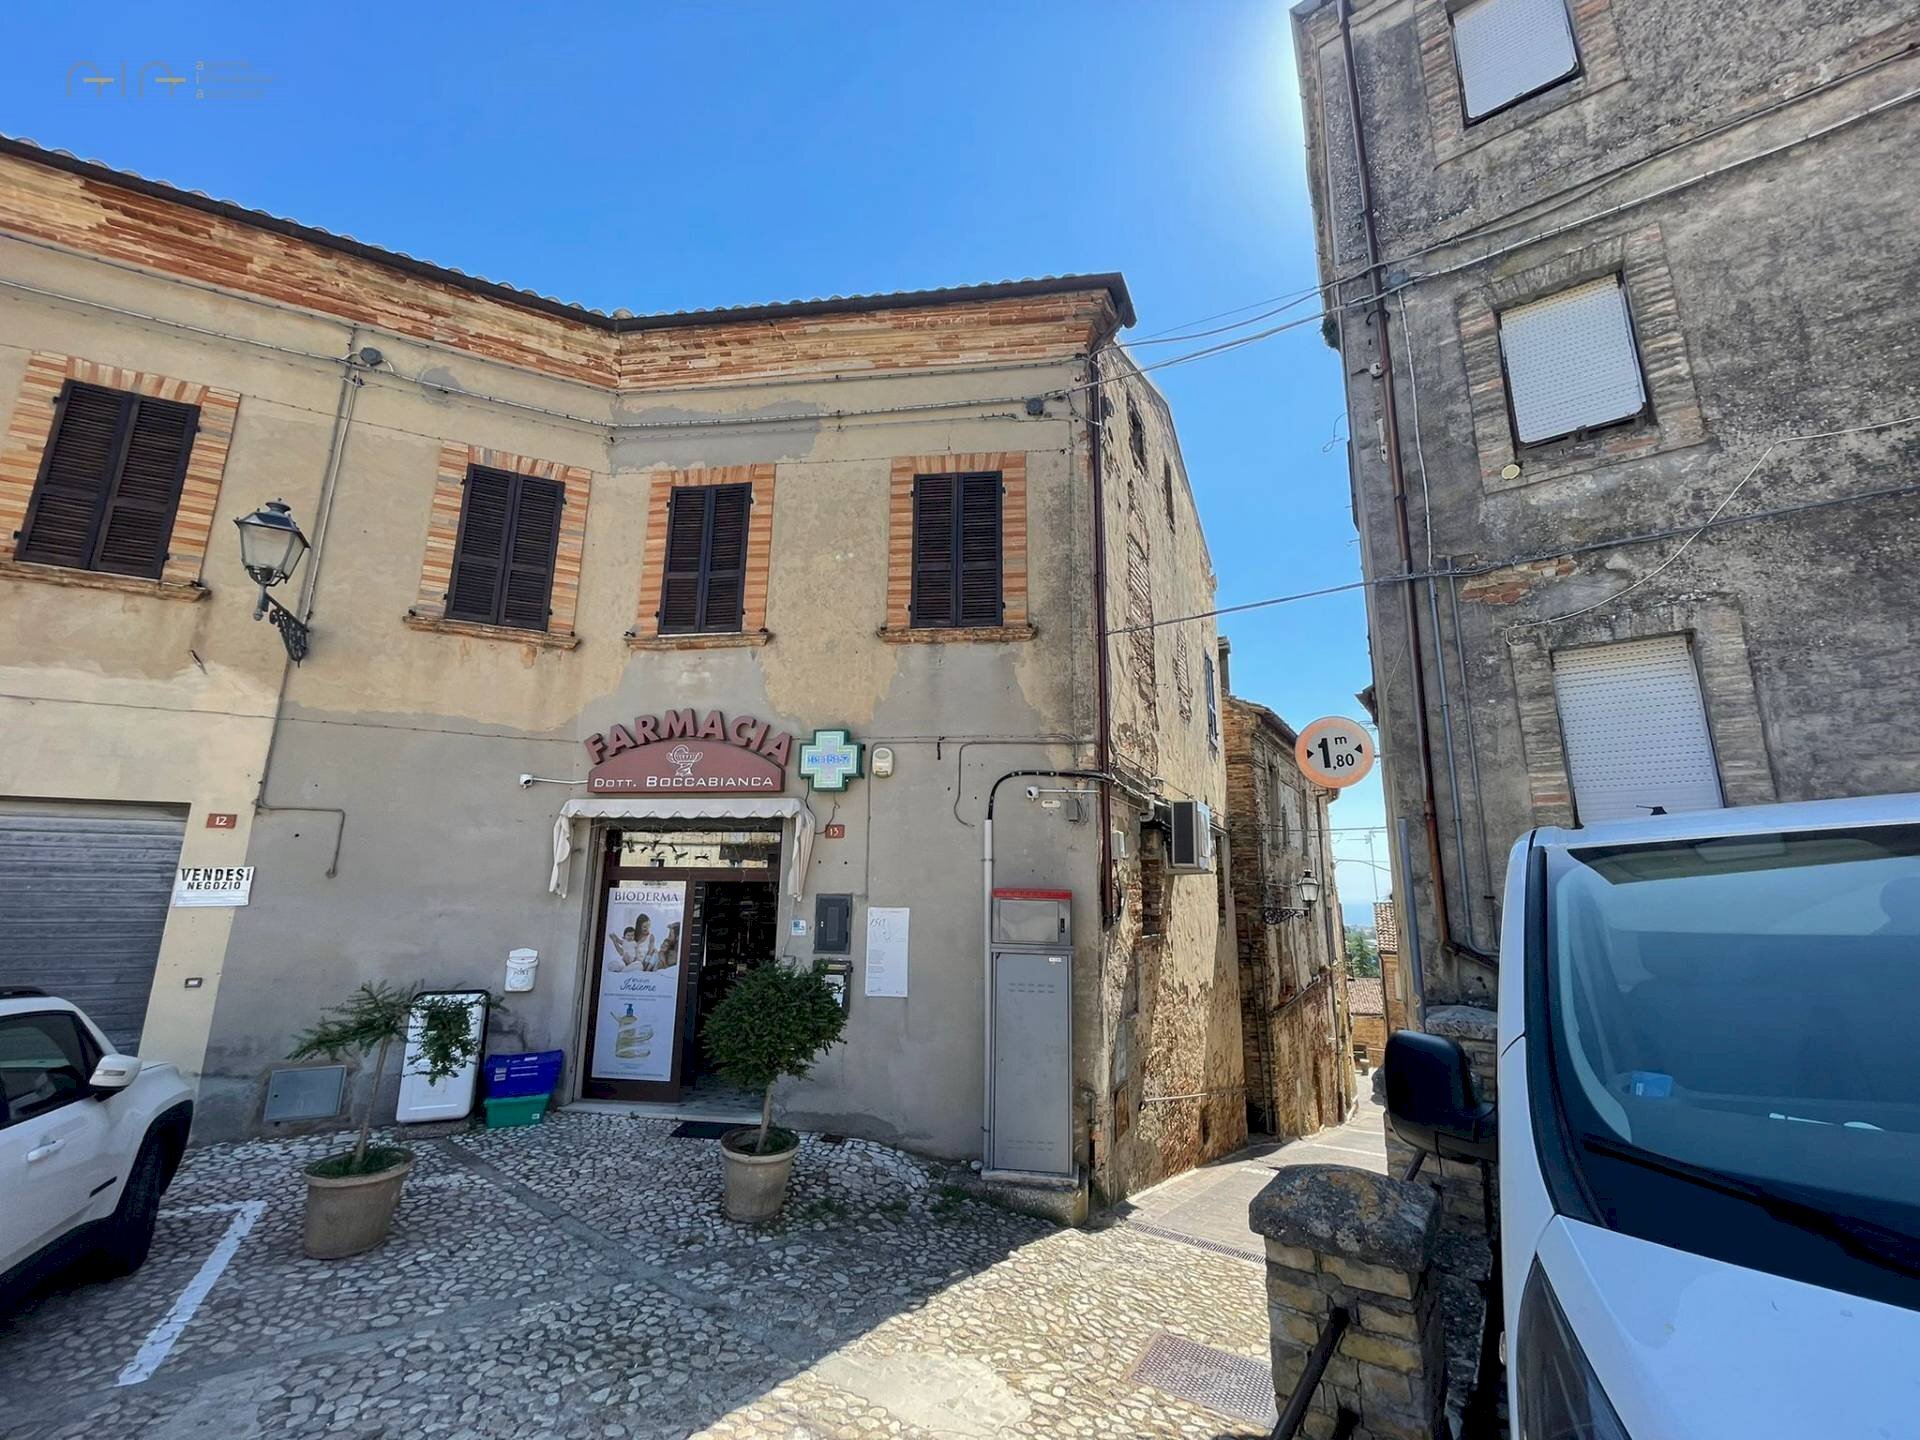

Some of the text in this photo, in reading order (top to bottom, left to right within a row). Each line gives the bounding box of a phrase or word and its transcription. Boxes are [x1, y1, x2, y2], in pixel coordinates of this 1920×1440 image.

[584, 708, 793, 766] FARMACIA
[594, 775, 774, 788] DOTT. BOCCABIANCA
[215, 816, 227, 826] 12
[181, 868, 251, 881] VENDESI
[187, 881, 241, 890] NEGOZIO
[614, 891, 679, 902] BIODERMA
